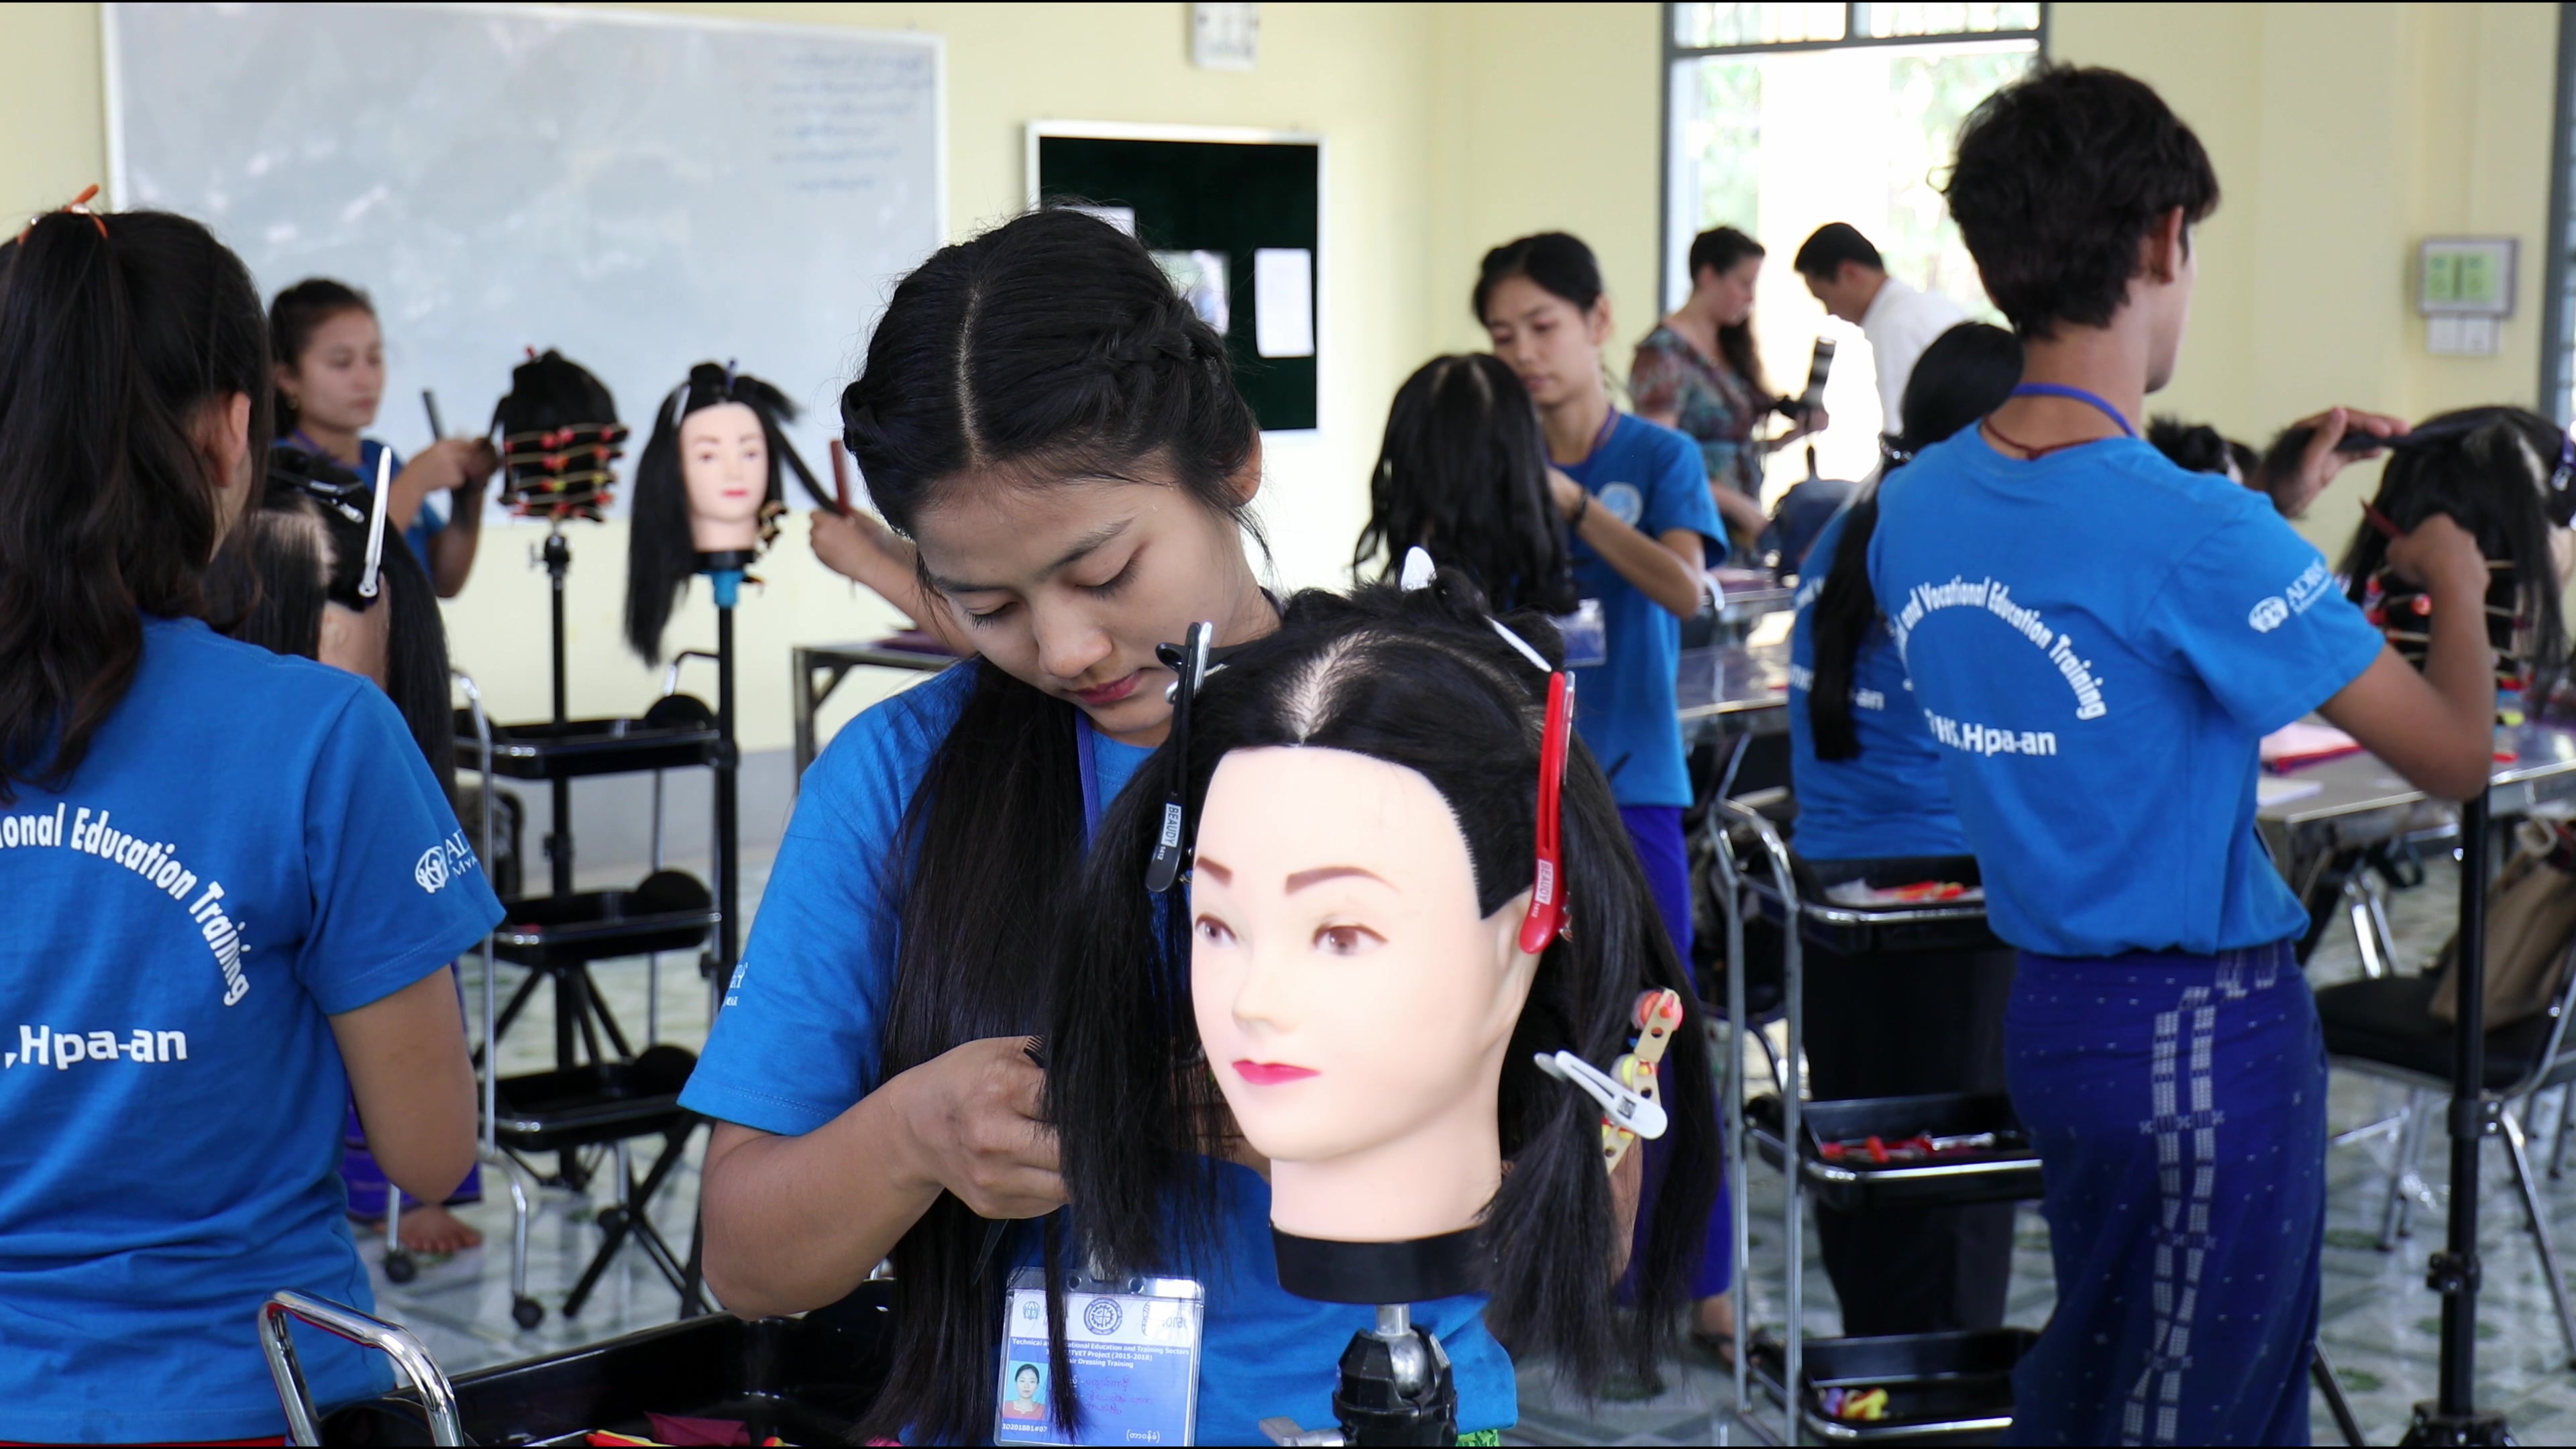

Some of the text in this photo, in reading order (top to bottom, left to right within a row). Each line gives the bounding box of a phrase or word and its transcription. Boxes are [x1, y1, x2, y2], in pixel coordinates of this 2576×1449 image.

[1917, 574, 1991, 612] Vocational
[1987, 581, 2053, 650] Education
[2048, 633, 2107, 720] Training
[1165, 806, 1179, 845] BEAUDY
[70, 806, 197, 901] Education
[188, 880, 251, 1006] Training
[1012, 1338, 1042, 1346] Technical
[1091, 1343, 1122, 1351] Education
[1137, 1346, 1163, 1355] Training
[1165, 1347, 1189, 1355] Sectors
[1087, 1350, 1110, 1358] Project
[1112, 1352, 1152, 1362] (2015-2018)
[1078, 1358, 1106, 1367] Dressing
[1107, 1360, 1134, 1368] Training
